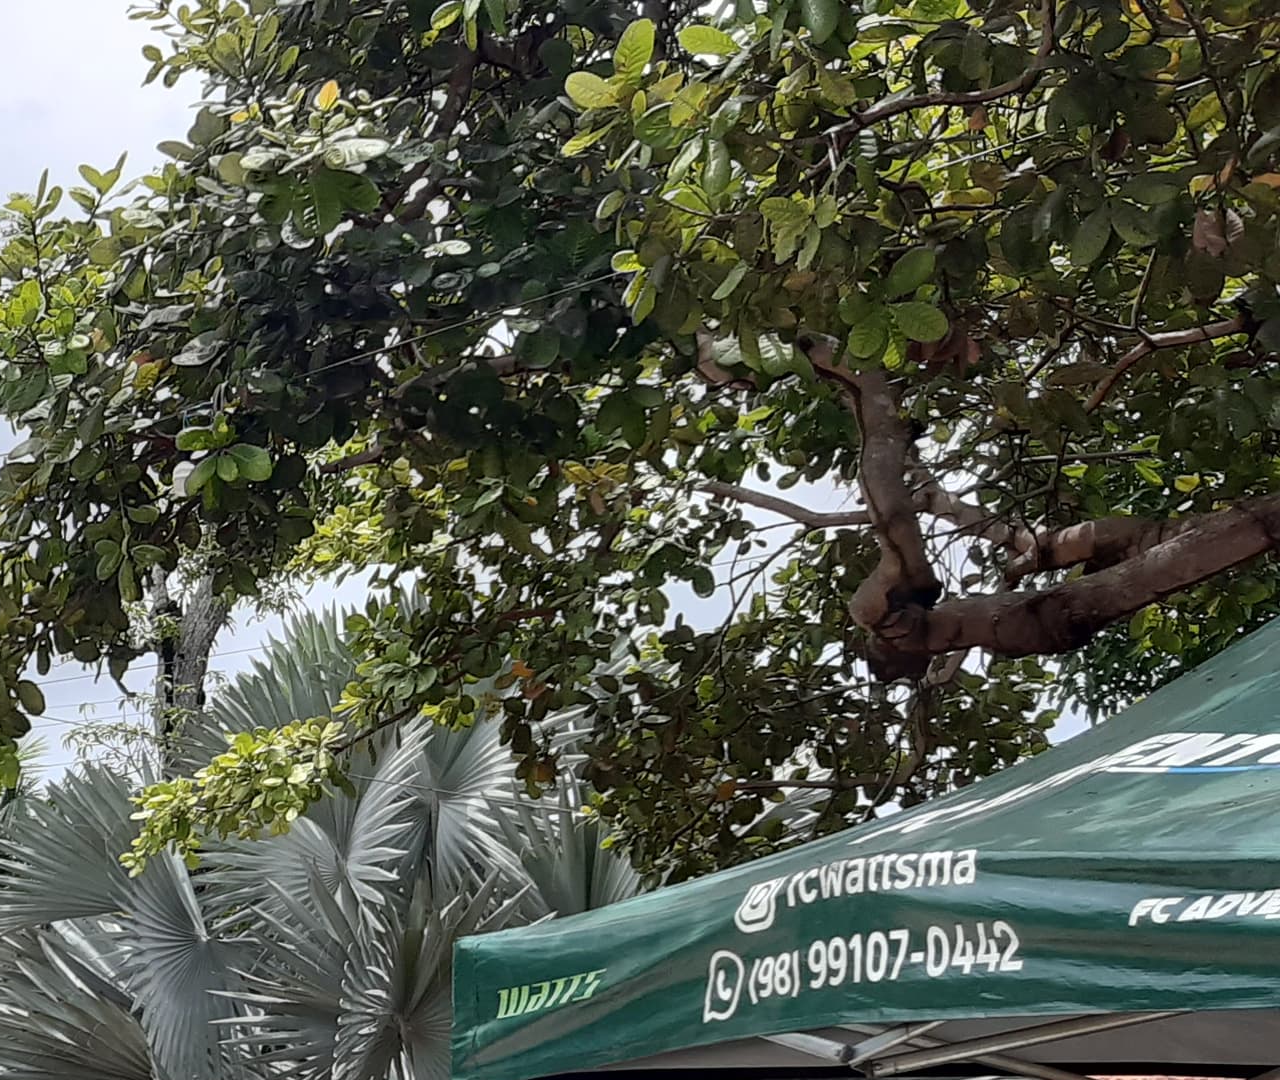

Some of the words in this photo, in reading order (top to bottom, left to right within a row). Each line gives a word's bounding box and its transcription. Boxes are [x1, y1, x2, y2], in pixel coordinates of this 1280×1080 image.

[786, 849, 977, 907] rcwattsma
[1128, 896, 1185, 927] FC
[748, 950, 801, 1005] (98)
[808, 920, 1024, 990] 99107-0442
